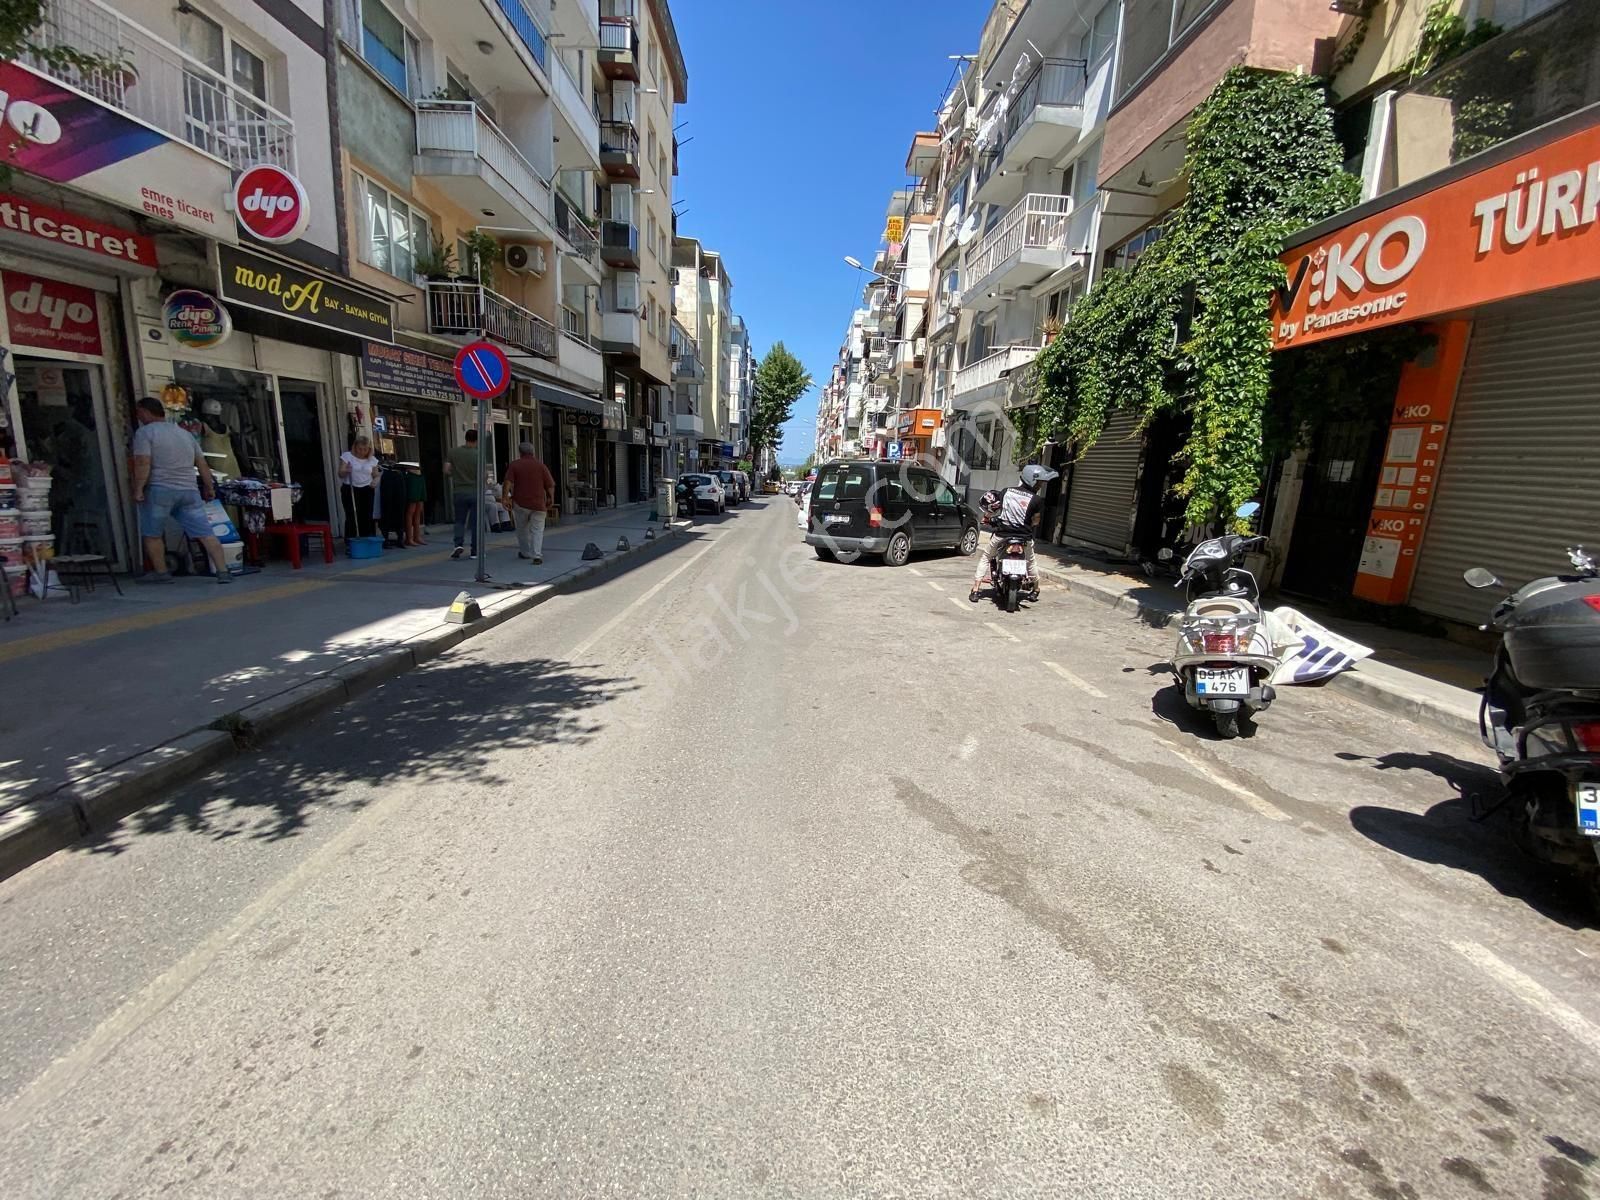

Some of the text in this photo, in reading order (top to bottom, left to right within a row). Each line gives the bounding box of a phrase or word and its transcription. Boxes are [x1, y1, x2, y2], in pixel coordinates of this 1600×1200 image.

[141, 186, 215, 224] emre ticaret
[143, 200, 175, 221] enes
[243, 187, 295, 219] dyo
[0, 201, 139, 260] ticaret
[10, 282, 94, 330] dyo
[177, 307, 212, 324] dyo
[324, 297, 340, 310] BAY
[345, 304, 368, 320] BAYAN
[1279, 291, 1407, 341] by Panasonic
[889, 443, 899, 457] P
[1402, 424, 1444, 556] Panasonic
[1199, 669, 1244, 680] 09 AKV
[1211, 682, 1237, 692] 476
[1584, 786, 1598, 803] 3
